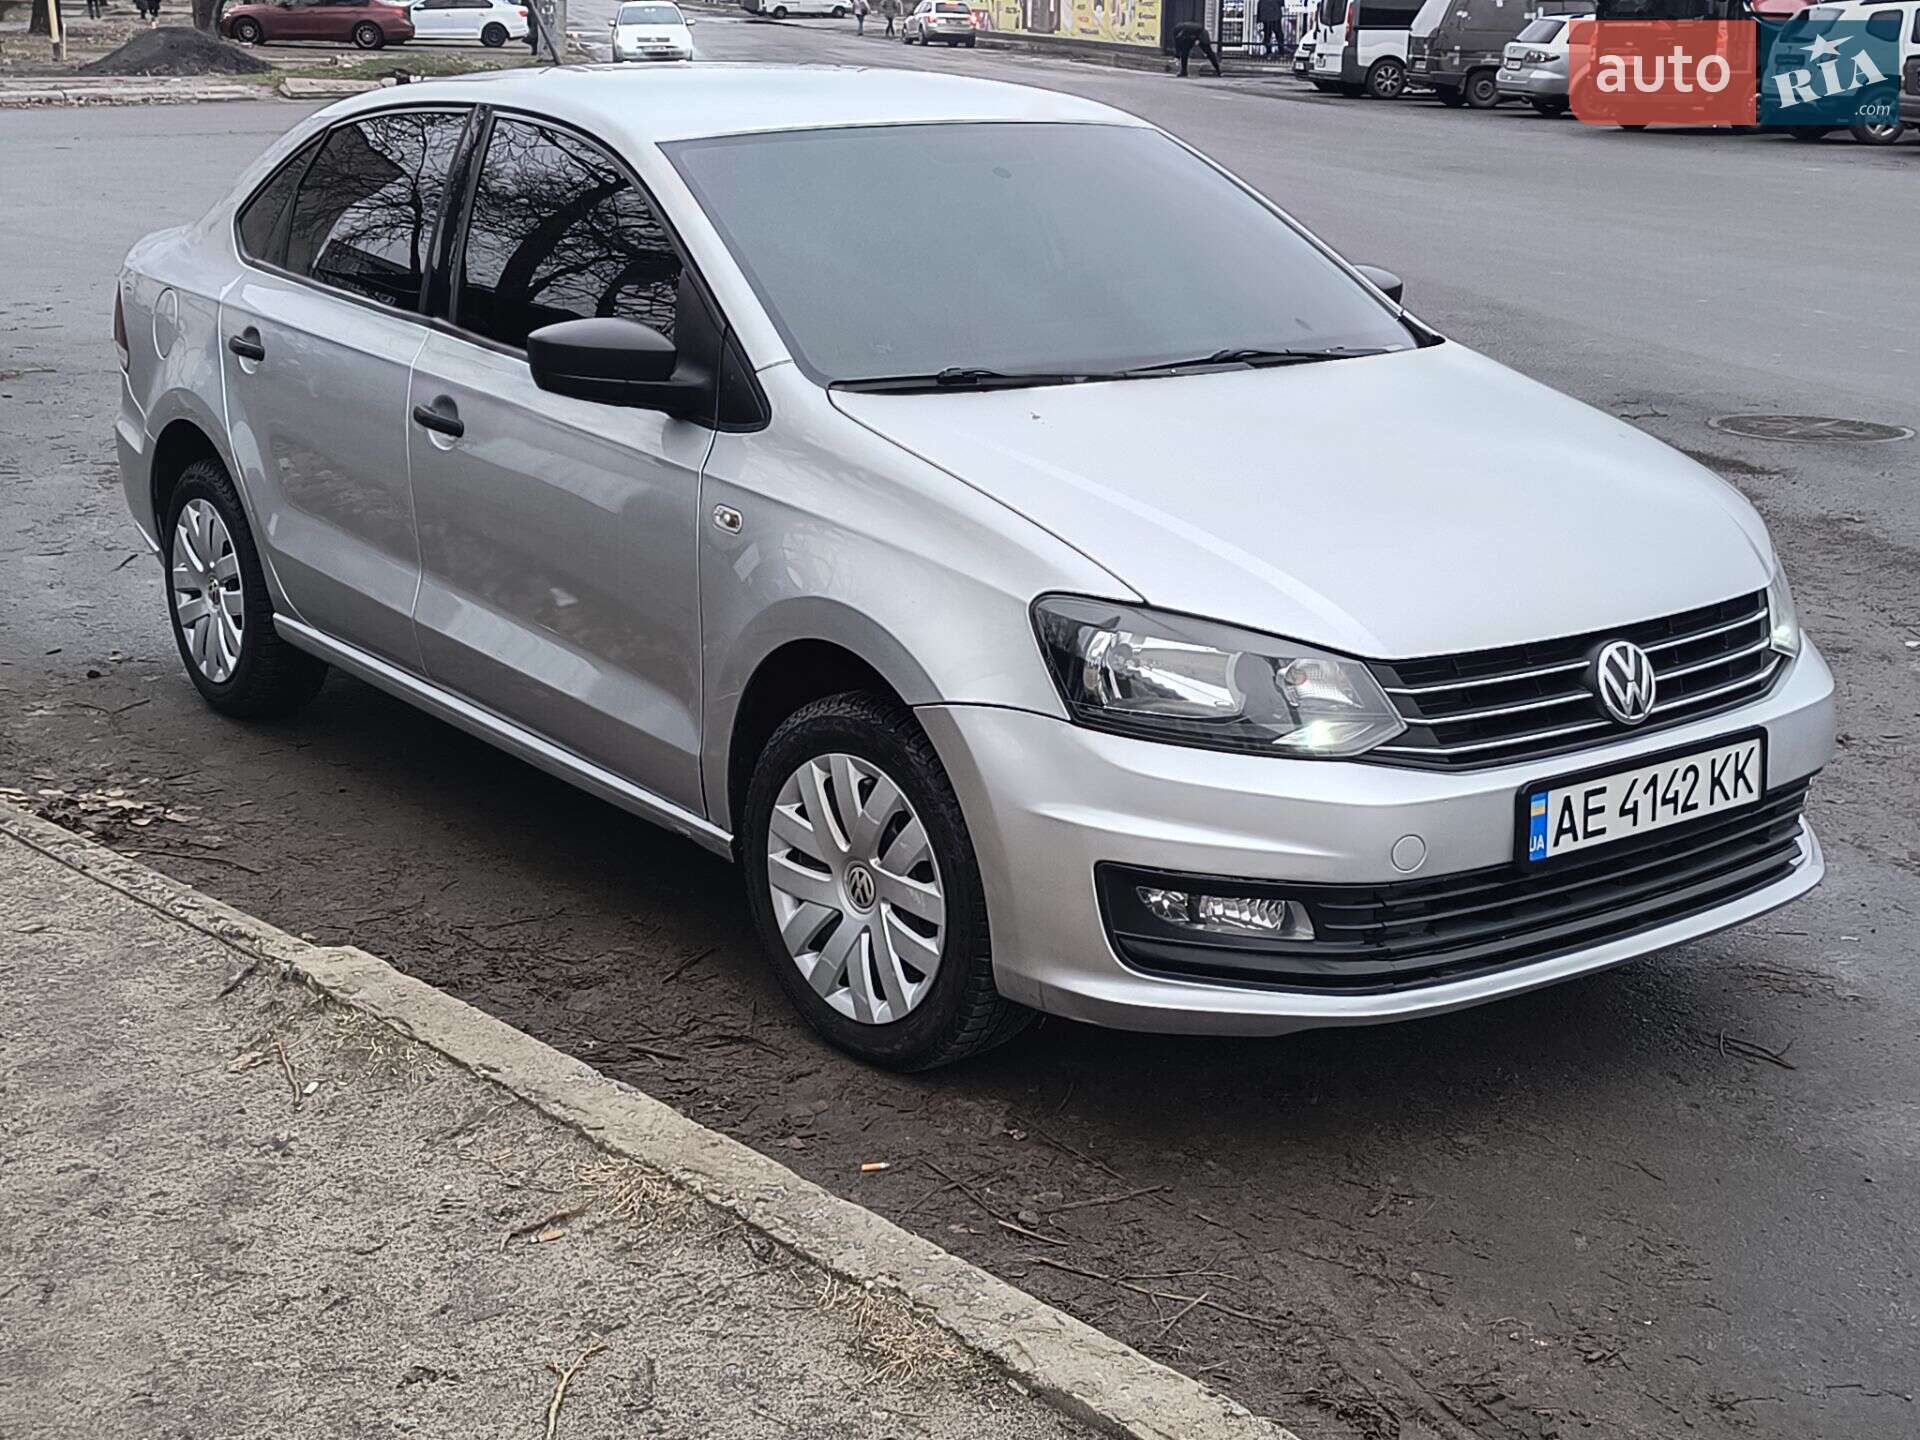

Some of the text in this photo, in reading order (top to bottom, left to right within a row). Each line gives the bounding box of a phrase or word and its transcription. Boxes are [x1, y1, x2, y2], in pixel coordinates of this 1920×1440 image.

[1602, 643, 1653, 721] VW
[1553, 746, 1755, 847] AE 4142 KK
[1530, 834, 1544, 851] UA
